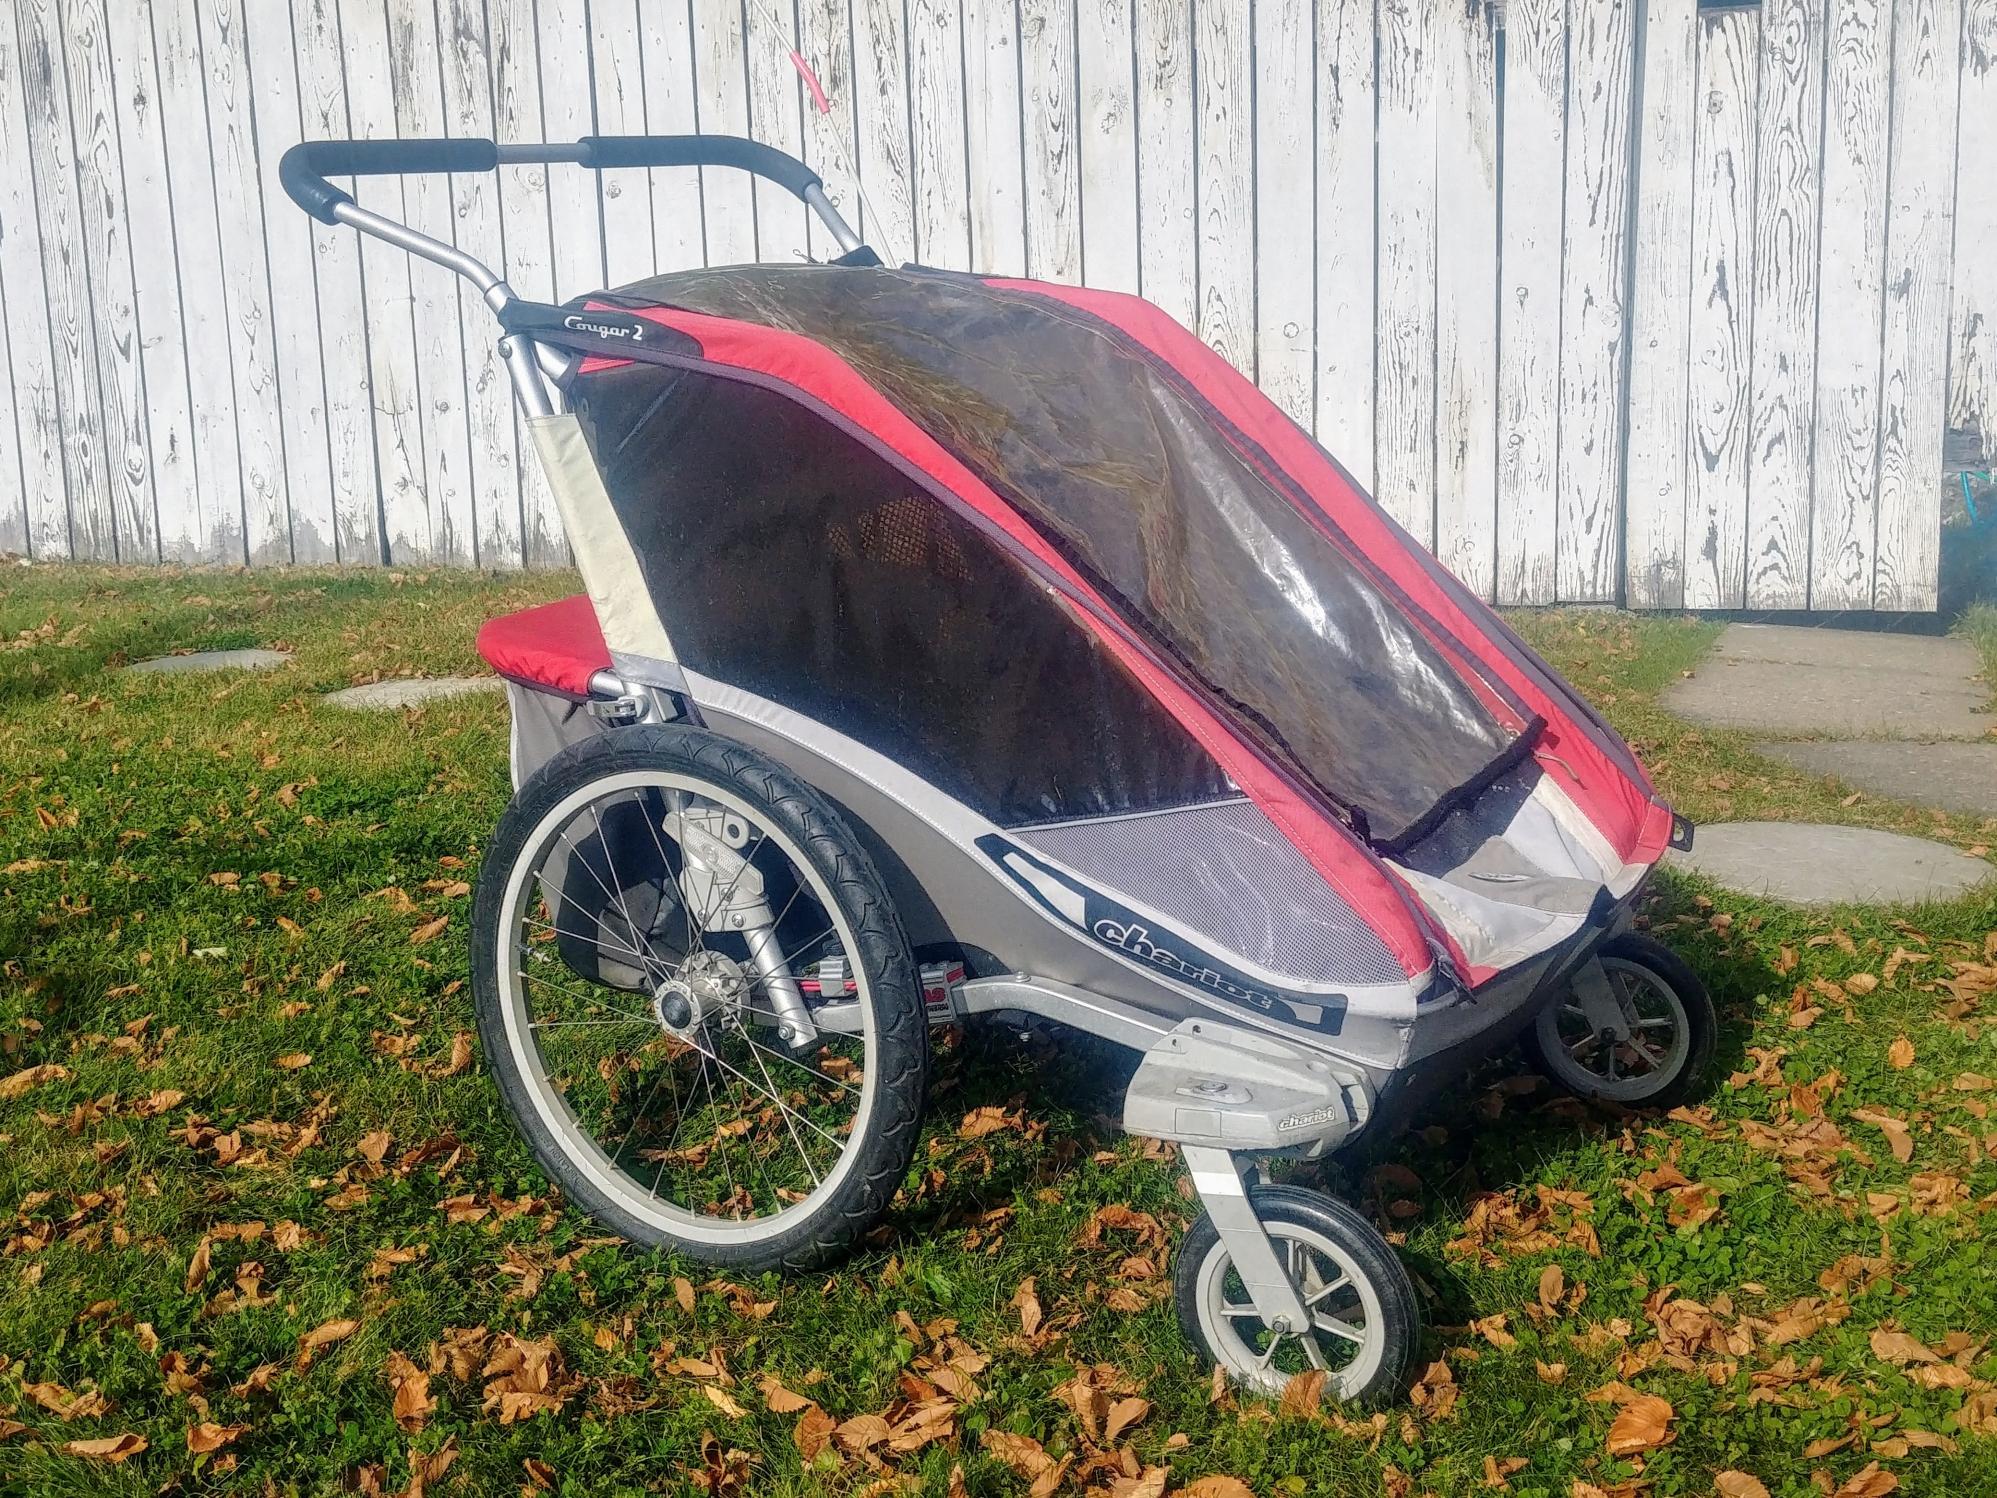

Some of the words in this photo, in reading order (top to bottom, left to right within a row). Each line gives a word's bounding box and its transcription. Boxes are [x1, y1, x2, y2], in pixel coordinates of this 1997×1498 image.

[564, 315, 630, 339] Cougar
[632, 324, 644, 341] 2
[1093, 919, 1272, 1010] chariot
[1278, 1106, 1335, 1131] chariot
